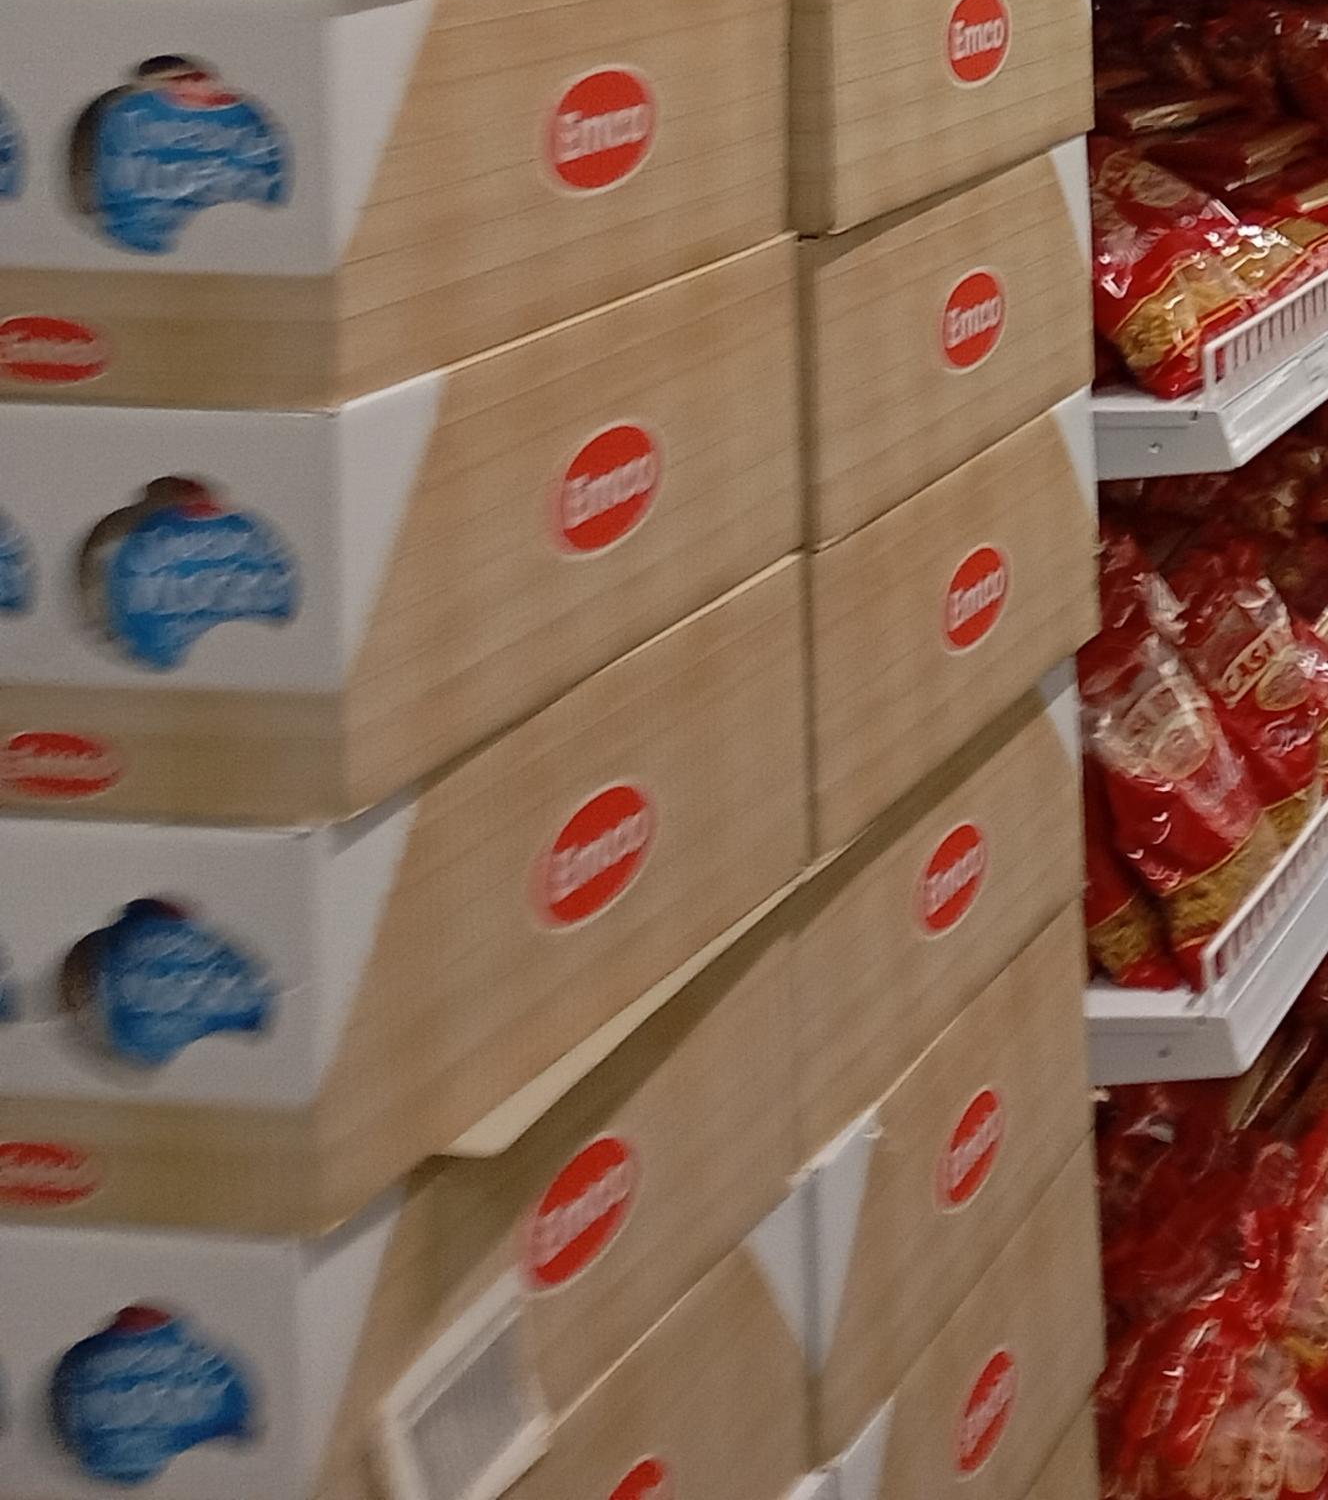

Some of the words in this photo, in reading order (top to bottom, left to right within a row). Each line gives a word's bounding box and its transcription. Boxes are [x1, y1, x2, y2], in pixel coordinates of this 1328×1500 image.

[952, 18, 1005, 61] Emco
[558, 103, 650, 164] Emco
[945, 296, 1002, 349] Emco
